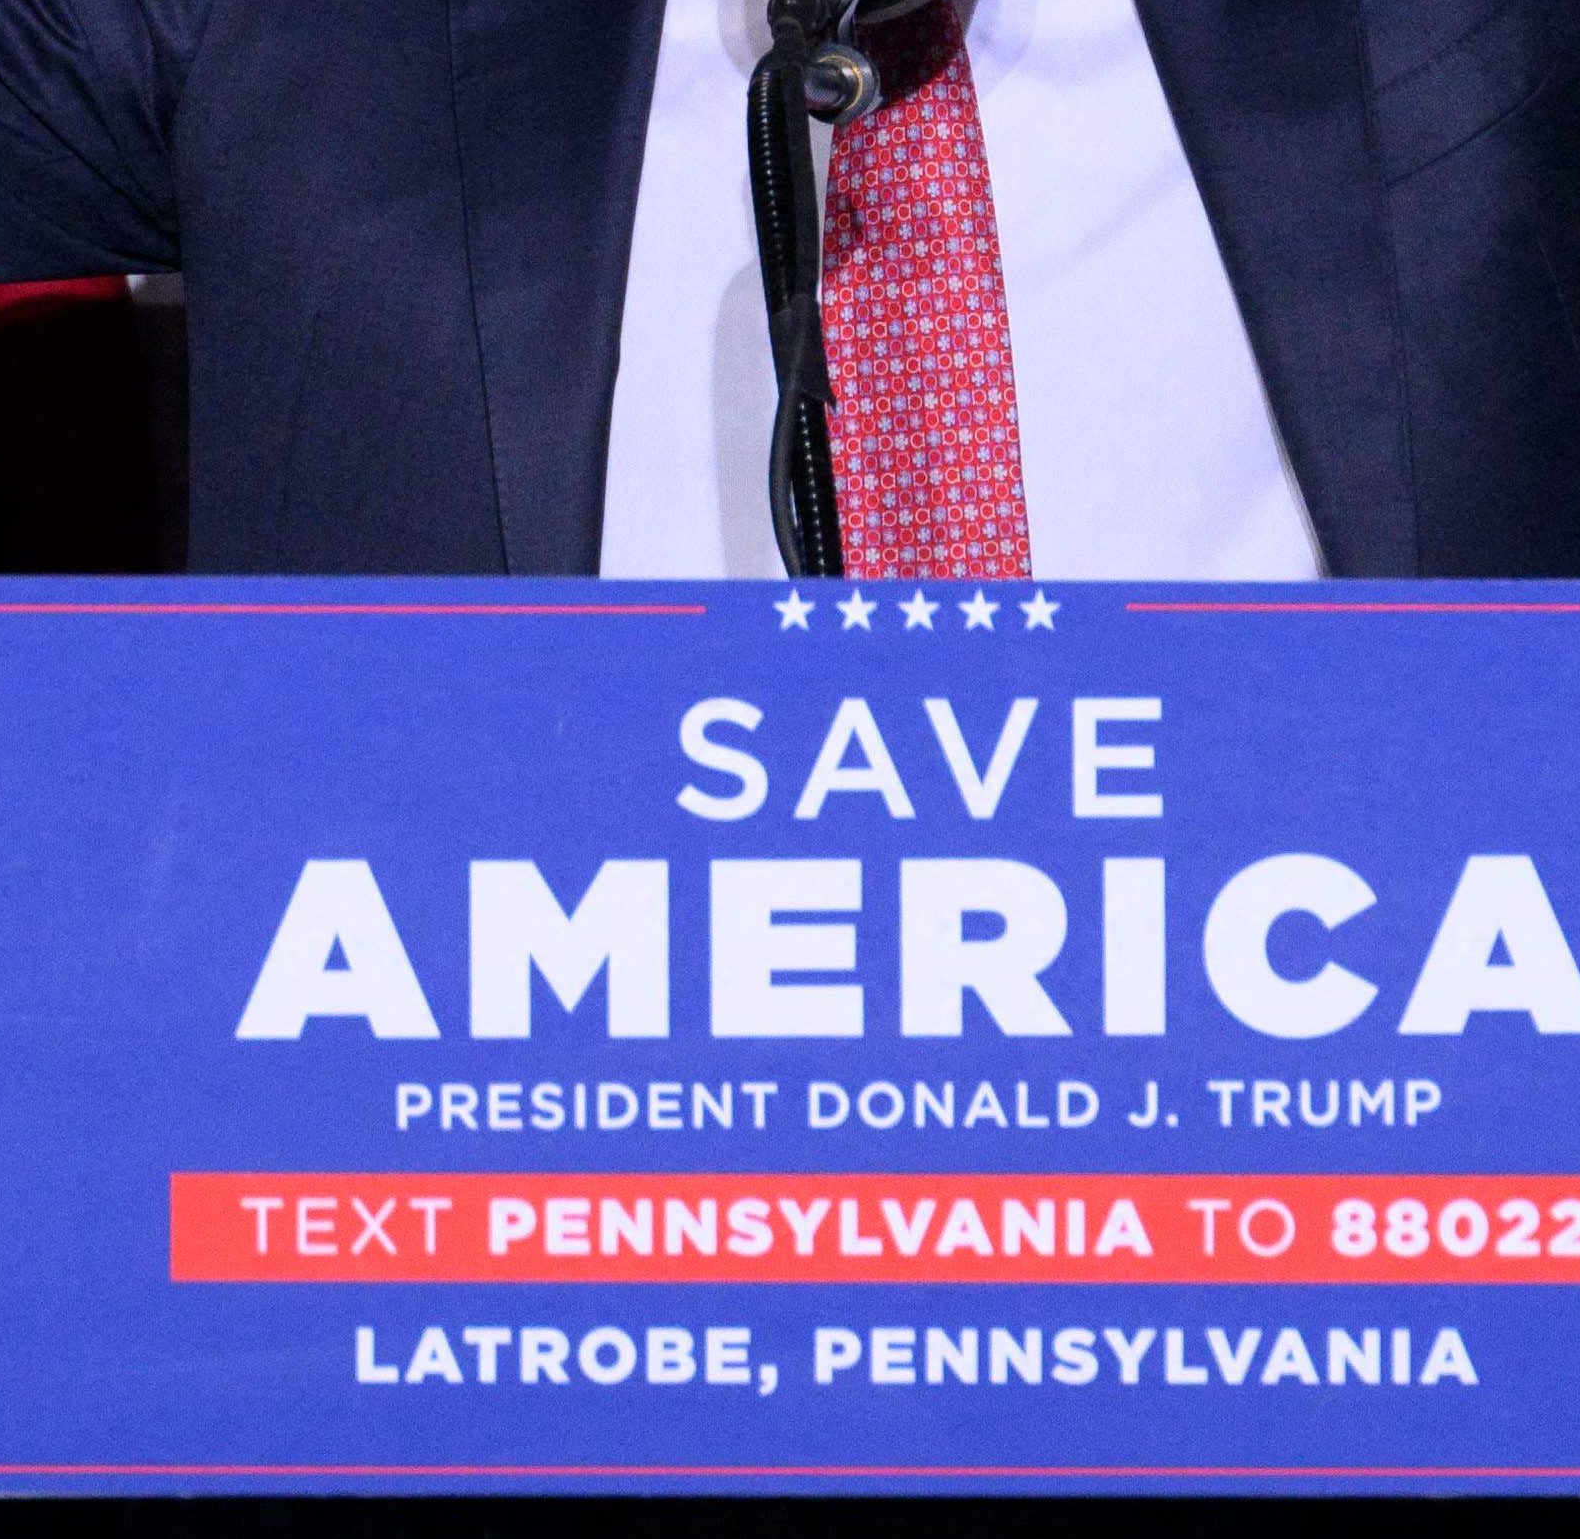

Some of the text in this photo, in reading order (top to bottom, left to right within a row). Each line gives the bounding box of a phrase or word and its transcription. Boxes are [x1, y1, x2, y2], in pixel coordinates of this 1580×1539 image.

[677, 697, 1165, 822] SAVE
[395, 1079, 1443, 1131] PRESIDENT DONALD J. TRUMP
[240, 1196, 454, 1256] TEXT
[487, 1197, 1154, 1258] PENNSYLVANIA
[1188, 1197, 1297, 1258] TO
[355, 1326, 1479, 1397] LATROBE, PENNSYLVANIA
